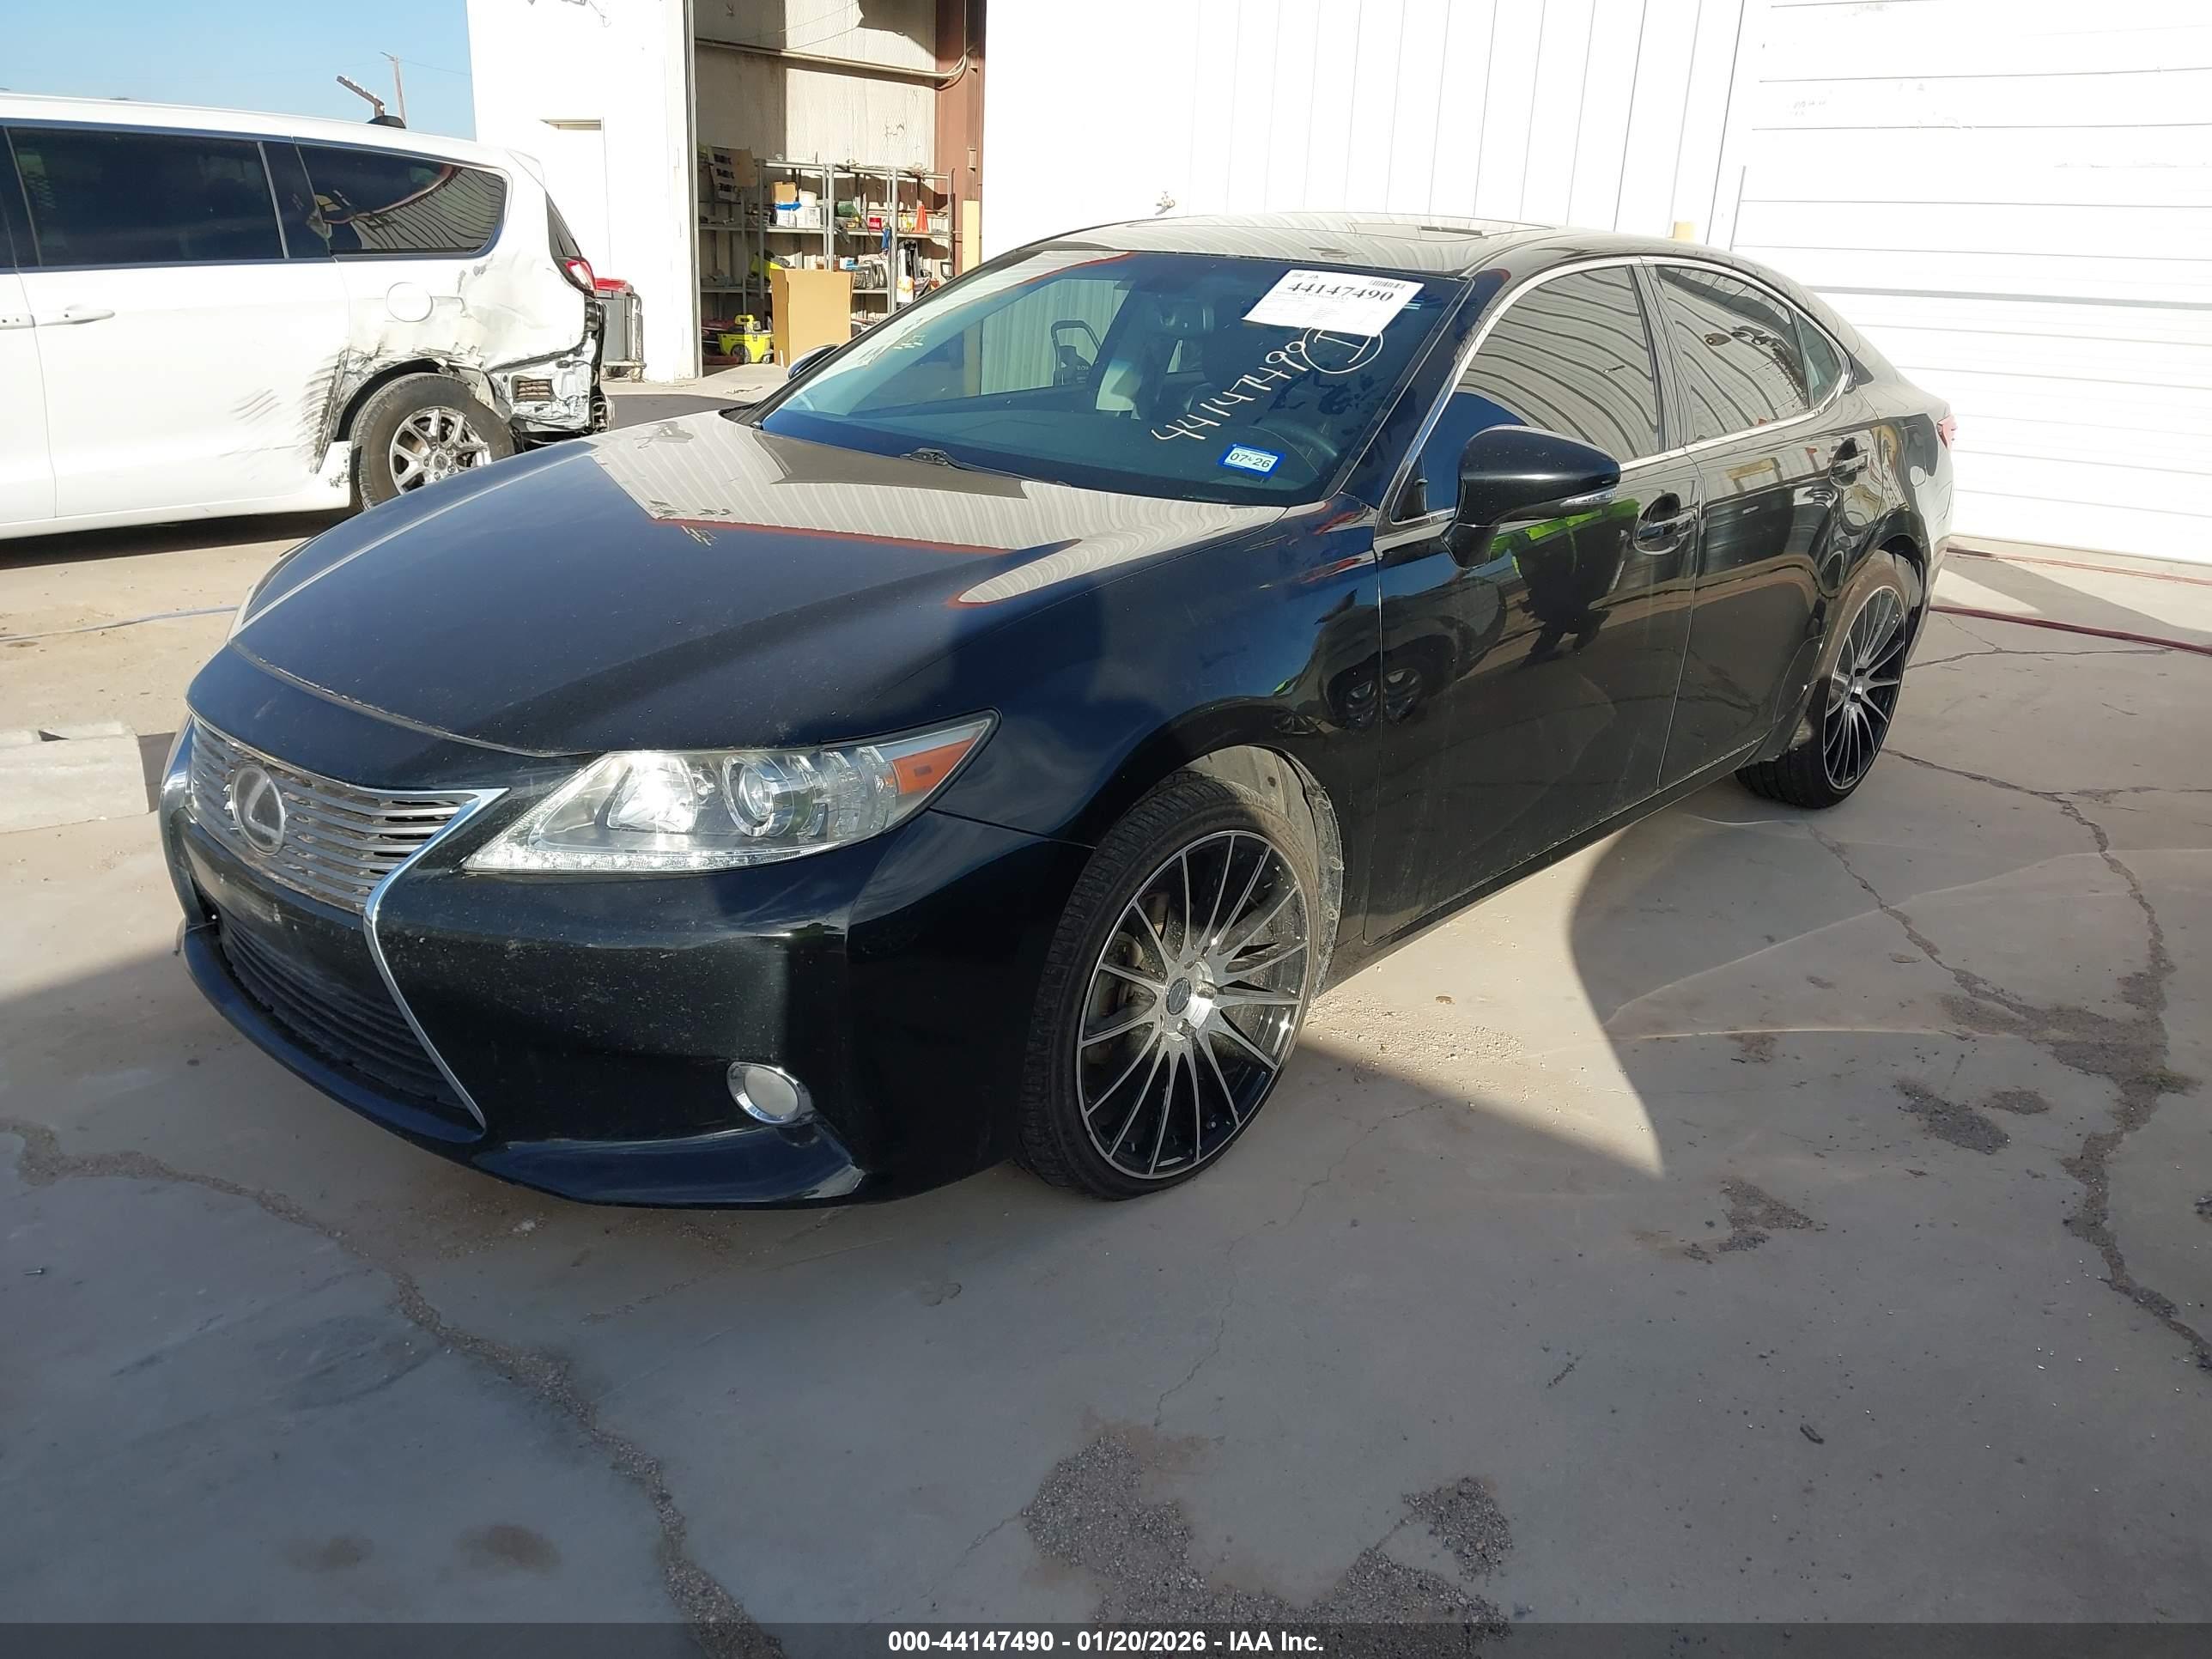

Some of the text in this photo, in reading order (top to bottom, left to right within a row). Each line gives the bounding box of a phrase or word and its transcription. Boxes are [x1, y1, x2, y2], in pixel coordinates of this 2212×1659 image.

[1287, 282, 1395, 301] 44147490
[1230, 453, 1272, 468] 07 26
